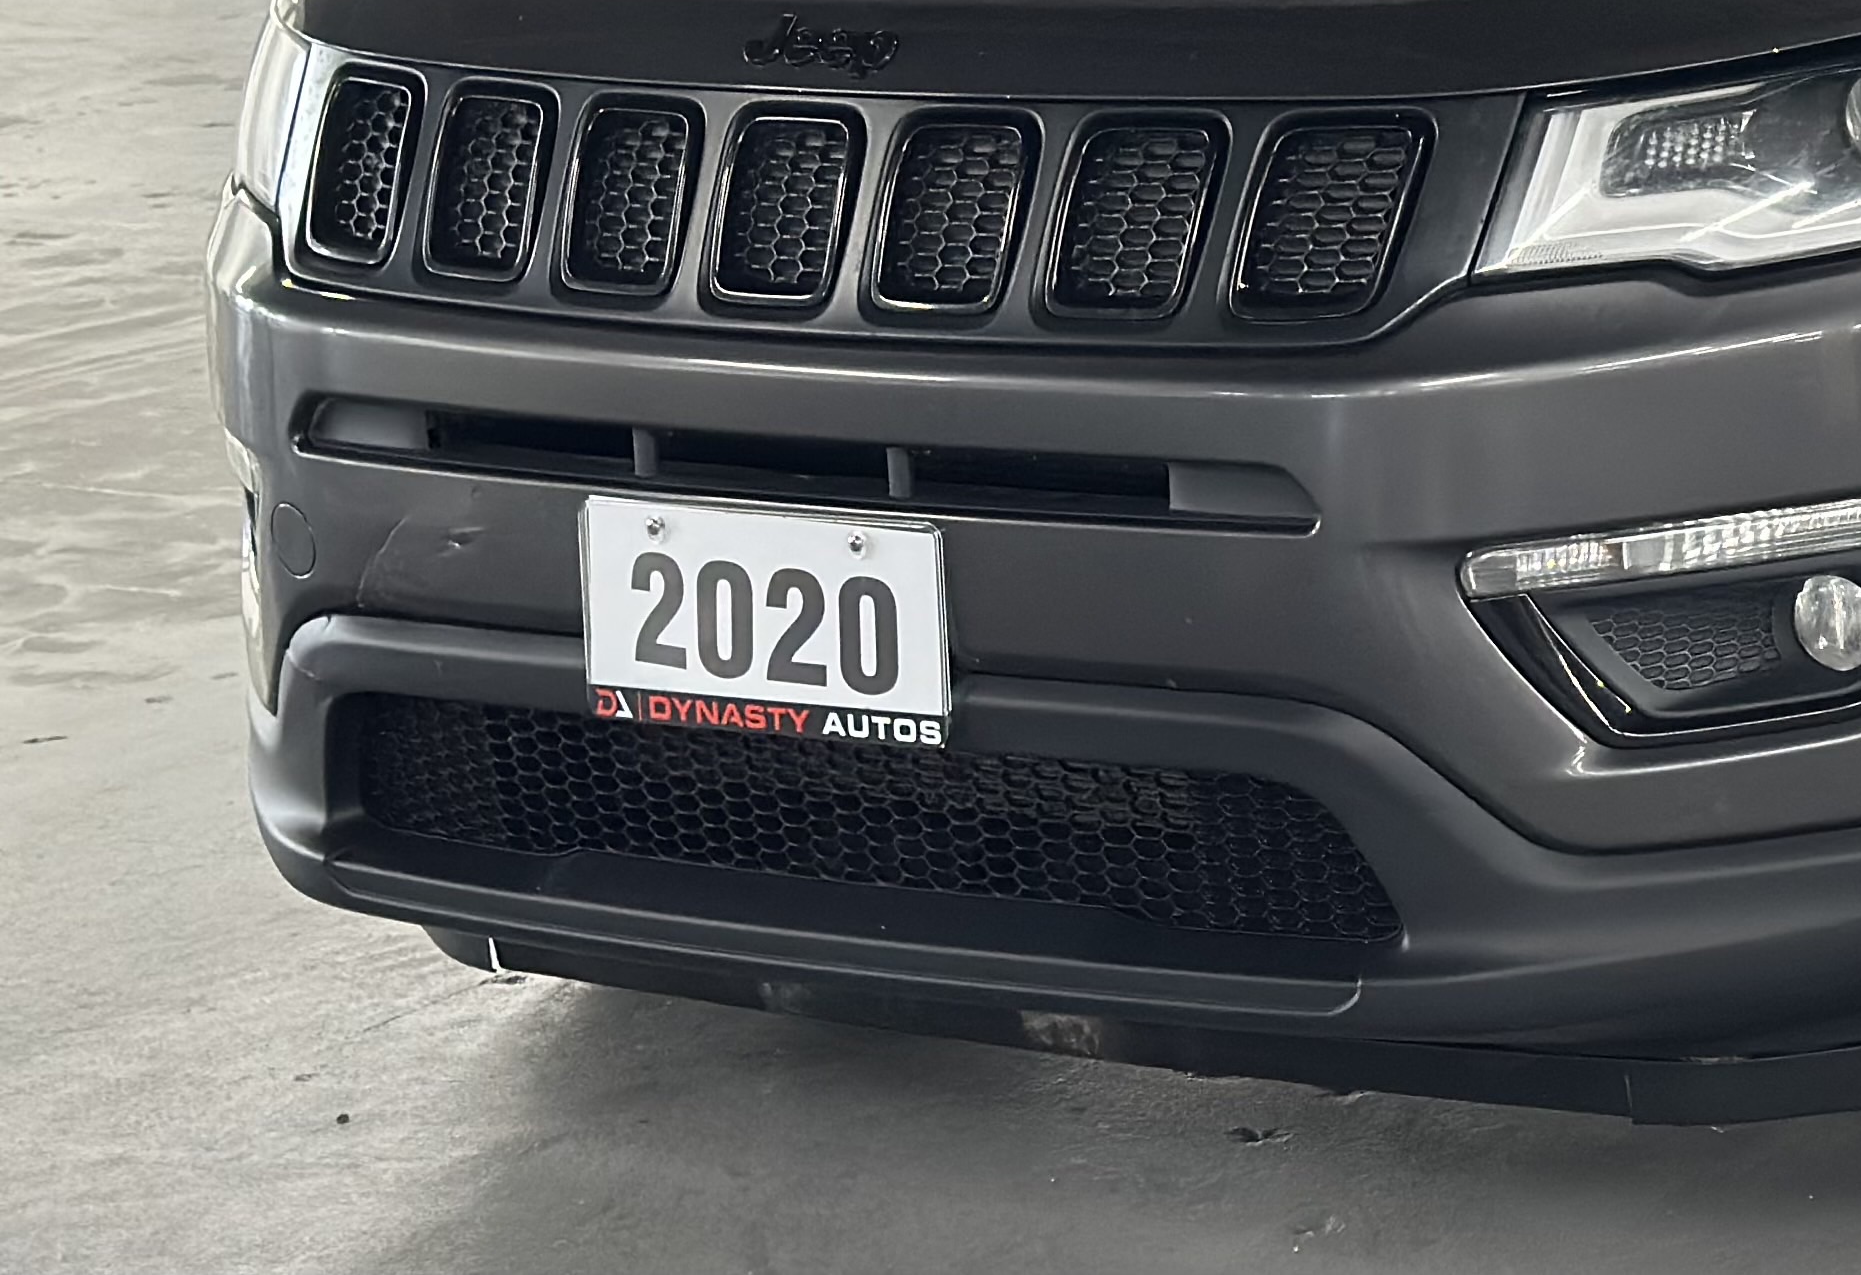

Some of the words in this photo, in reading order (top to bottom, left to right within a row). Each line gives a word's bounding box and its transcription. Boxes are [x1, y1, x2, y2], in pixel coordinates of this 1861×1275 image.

[742, 13, 899, 79] Jeep
[630, 551, 900, 696] 2020
[648, 694, 811, 733] DYNASTY
[822, 711, 942, 745] AUTOS
